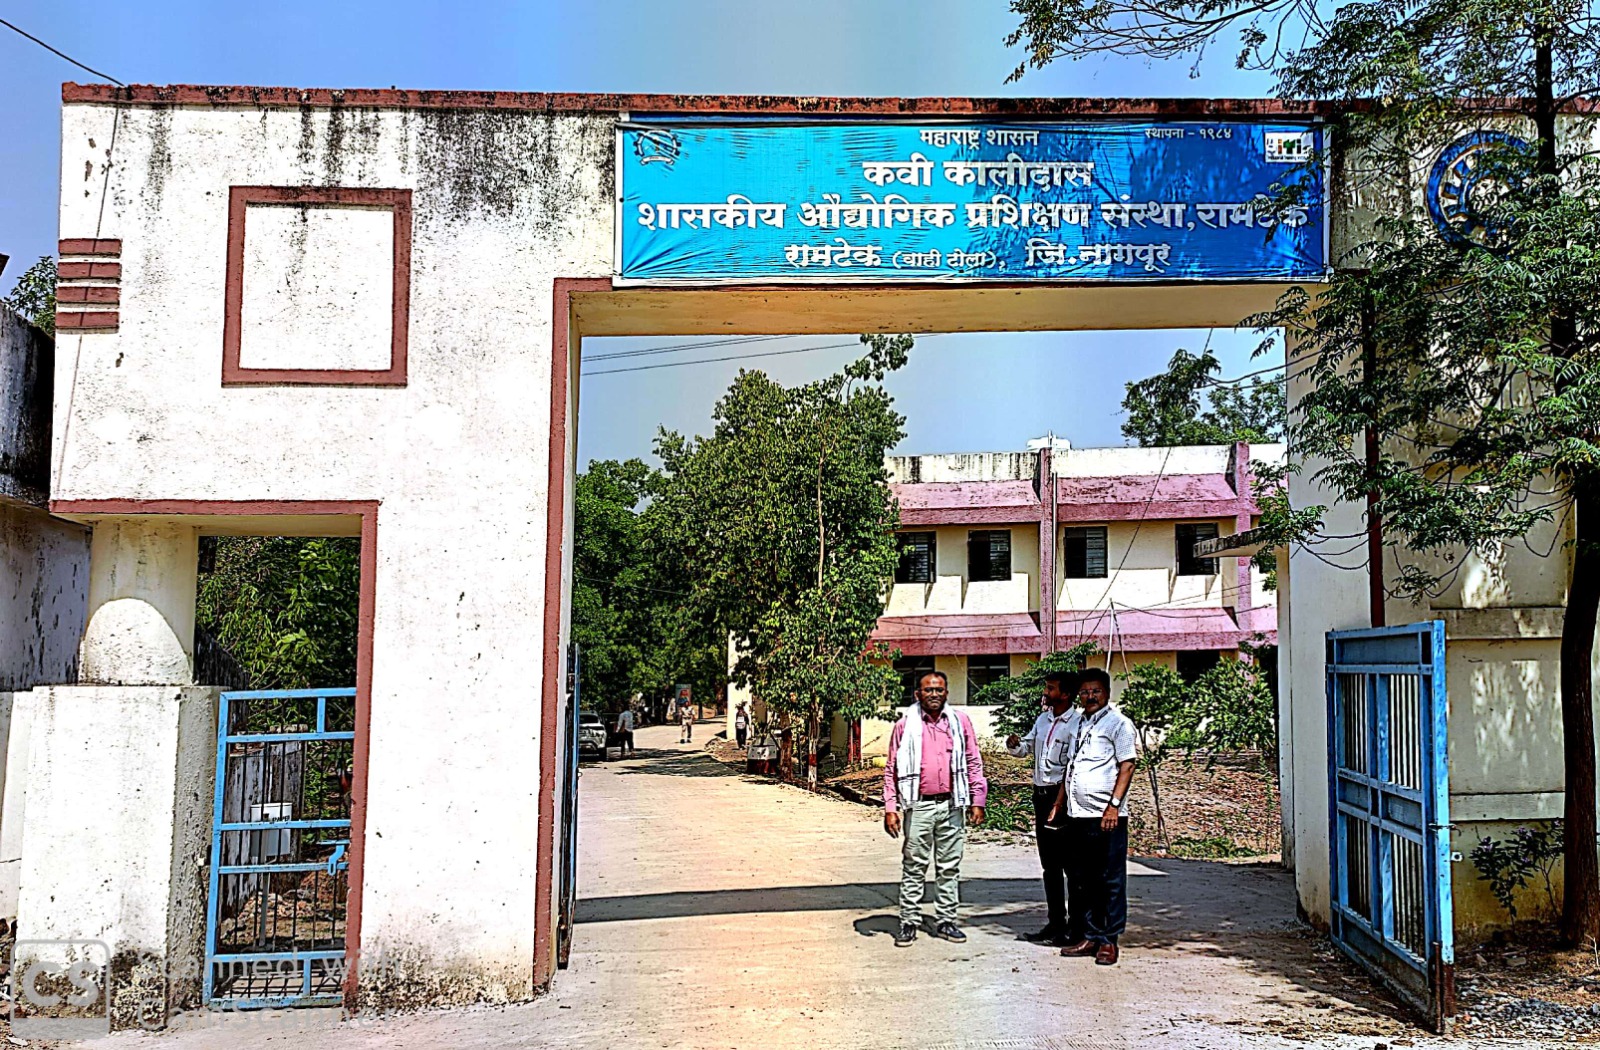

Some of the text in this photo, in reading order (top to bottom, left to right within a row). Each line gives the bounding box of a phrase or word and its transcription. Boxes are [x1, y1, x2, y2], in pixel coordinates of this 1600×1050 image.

[919, 129, 1040, 150] महाराष्ट्र शासन
[1145, 127, 1185, 139] स्थापना
[1198, 127, 1232, 140] १९८४
[864, 153, 1095, 192] कवी कालीदास
[638, 194, 787, 230] शासकीय
[797, 193, 956, 230] औद्योगिक
[965, 193, 1092, 232] प्रशिक्षण
[784, 238, 883, 268] रामटेक
